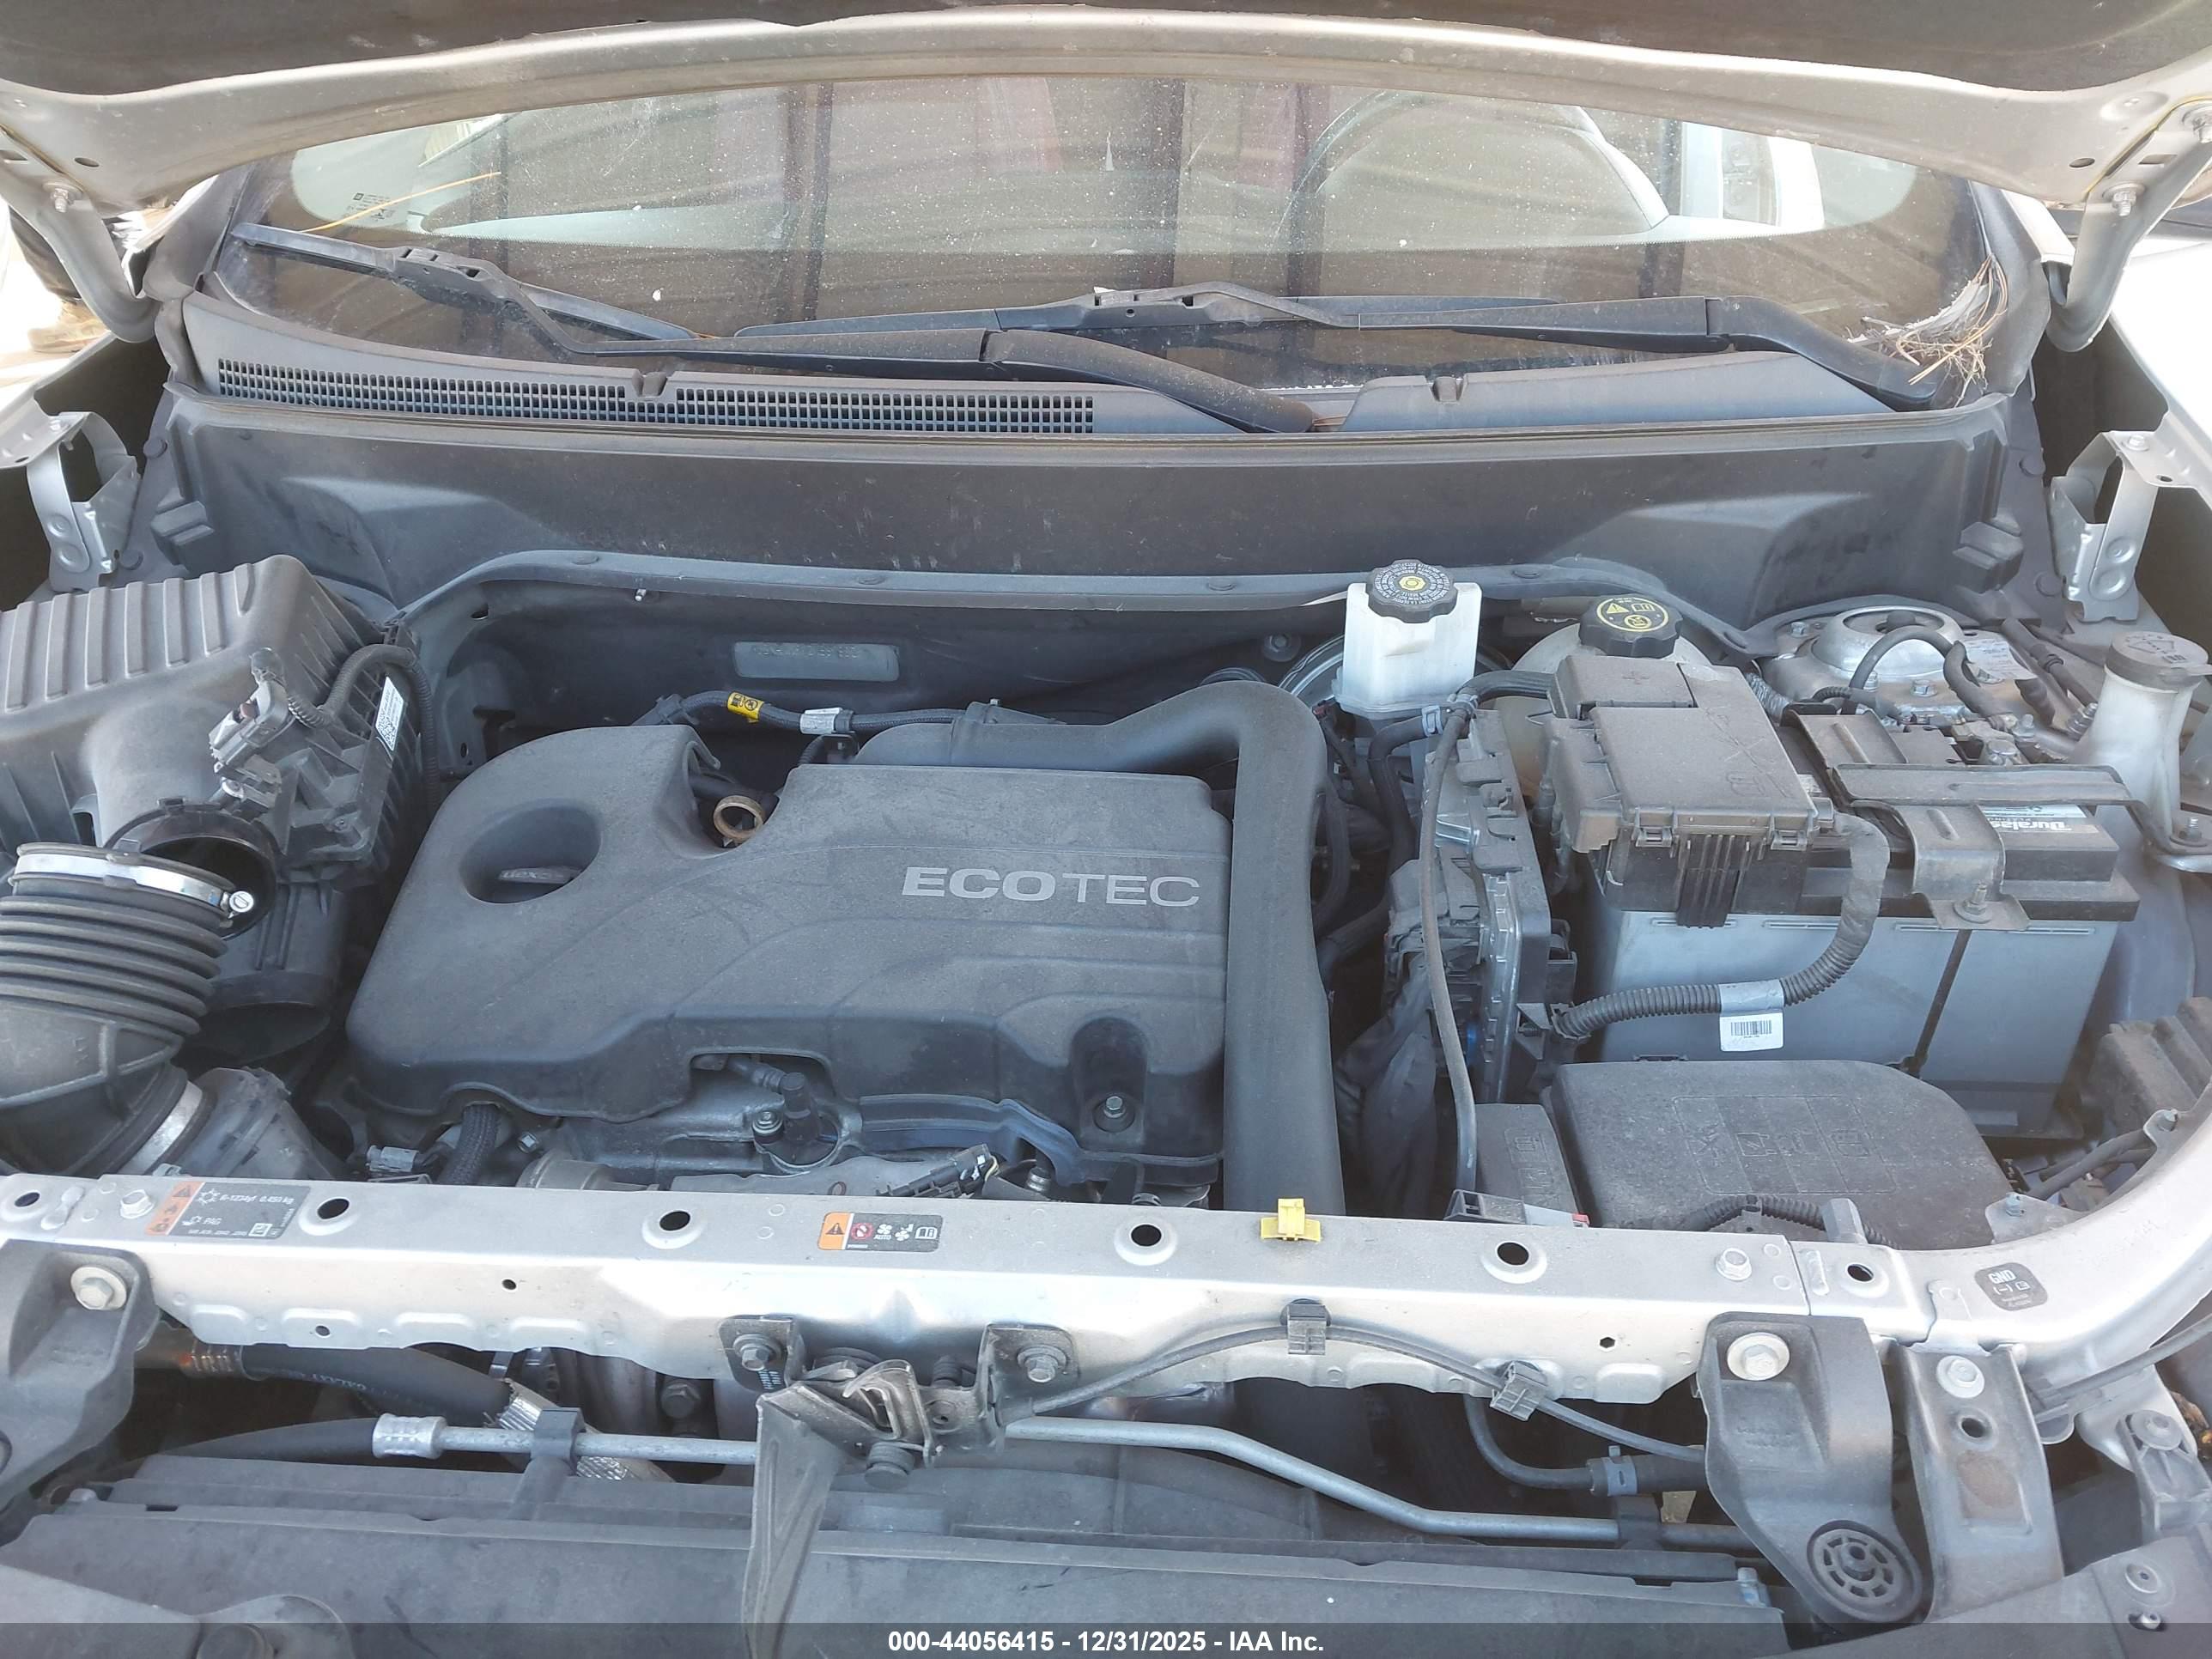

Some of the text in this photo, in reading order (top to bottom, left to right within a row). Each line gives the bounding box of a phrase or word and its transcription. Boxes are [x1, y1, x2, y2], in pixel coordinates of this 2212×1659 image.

[1988, 821, 2072, 831] Duralas
[902, 866, 1200, 907] ECOTEC
[1988, 1269, 2017, 1285] GND
